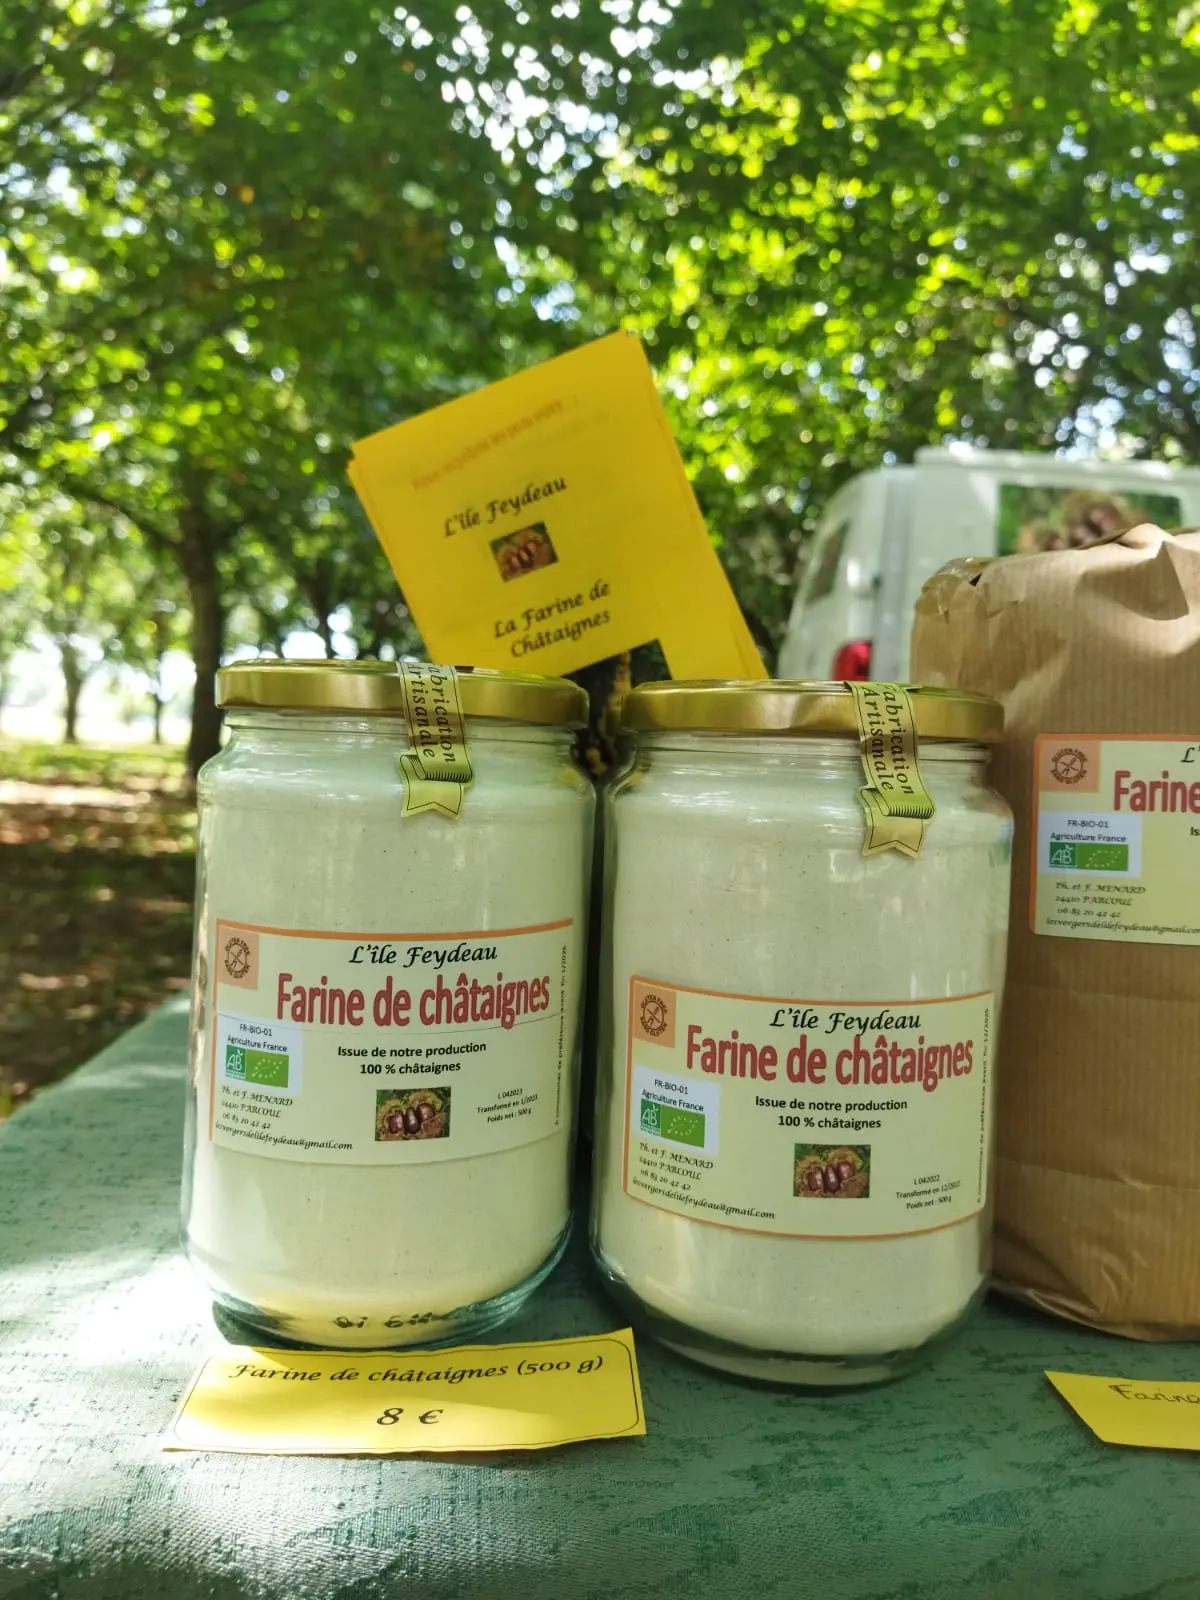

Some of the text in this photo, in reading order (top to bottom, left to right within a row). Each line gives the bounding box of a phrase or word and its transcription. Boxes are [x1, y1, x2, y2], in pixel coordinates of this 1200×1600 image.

[486, 477, 567, 524] Feydeau
[494, 578, 611, 639] La Farine de
[428, 665, 457, 763] abrication
[862, 686, 894, 791] Artisanale
[1067, 819, 1109, 828] FR-BIO-01
[1050, 832, 1127, 843] Agriculture France
[1096, 884, 1146, 894] MENARD
[348, 942, 498, 970] L'île Feydeau
[277, 971, 550, 1030] Farine de châtaignes
[239, 1023, 273, 1037] FR-BIO-01
[769, 1008, 921, 1036] L'île Feydeau
[227, 1035, 288, 1053] Agriculture France
[338, 1042, 487, 1059] Issue de notre production
[227, 1054, 242, 1071] AB
[687, 1024, 973, 1092] Farine de châtaignes
[360, 1061, 461, 1076] 100 % châtaignes
[654, 1079, 688, 1095] FR-BIO-01
[250, 1093, 293, 1106] MENARD
[641, 1089, 704, 1112] Agriculture France
[755, 1095, 908, 1113] Issue de notre production
[240, 1103, 281, 1118] PARCOUL
[504, 1112, 514, 1120] net
[642, 1108, 657, 1126] AB
[778, 1115, 881, 1131] 100 % châtaignes
[669, 1152, 714, 1169] MENARD
[659, 1162, 701, 1180] PARCOUL
[896, 1187, 931, 1199] Transformé
[906, 1201, 923, 1209] Poids
[924, 1199, 934, 1207] net
[228, 1356, 603, 1384] Farine de châtaignes (500 g)
[376, 1407, 443, 1426] 8 €
